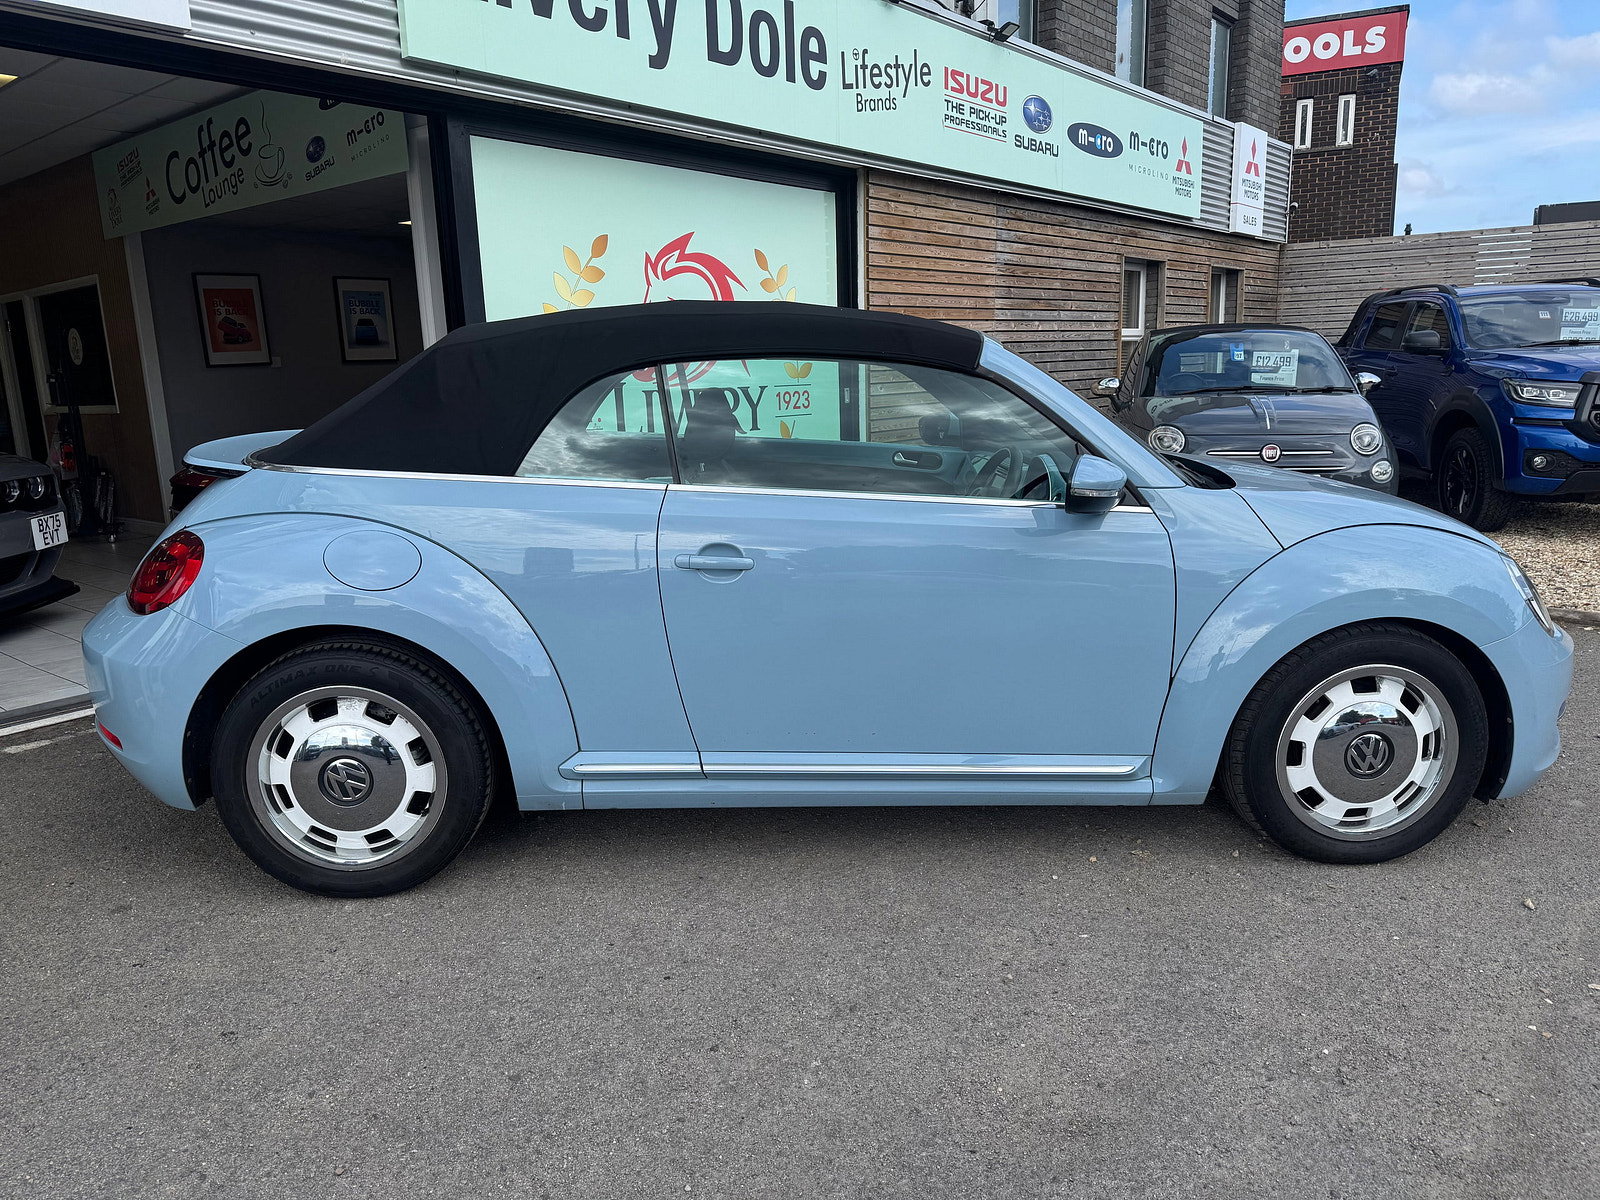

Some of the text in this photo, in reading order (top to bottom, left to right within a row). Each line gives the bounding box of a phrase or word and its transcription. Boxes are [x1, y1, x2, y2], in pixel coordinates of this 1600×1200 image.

[705, 0, 828, 91] Dole
[840, 48, 932, 98] Lifestyle
[943, 66, 1008, 107] ISUZU
[855, 91, 897, 113] Brands
[944, 99, 1007, 127] THE PICK-UP
[944, 113, 1007, 138] PROFESSIONALS
[1014, 133, 1059, 158] SUBARU
[116, 147, 140, 173] ISUZU
[166, 117, 252, 205] Coffee
[304, 156, 335, 182] SUBARU
[1128, 163, 1169, 181] MICROLINO
[1172, 175, 1195, 189] MITSUBISHI
[201, 167, 245, 208] Lounge
[1175, 186, 1192, 199] MOTORS
[1241, 177, 1262, 191] MITSUBISHI
[1243, 188, 1259, 201] MOTORS
[1242, 214, 1257, 227] SALES
[1563, 311, 1599, 322] £26,499
[775, 389, 811, 411] 1923
[37, 514, 61, 533] BX75
[42, 528, 60, 546] EVT
